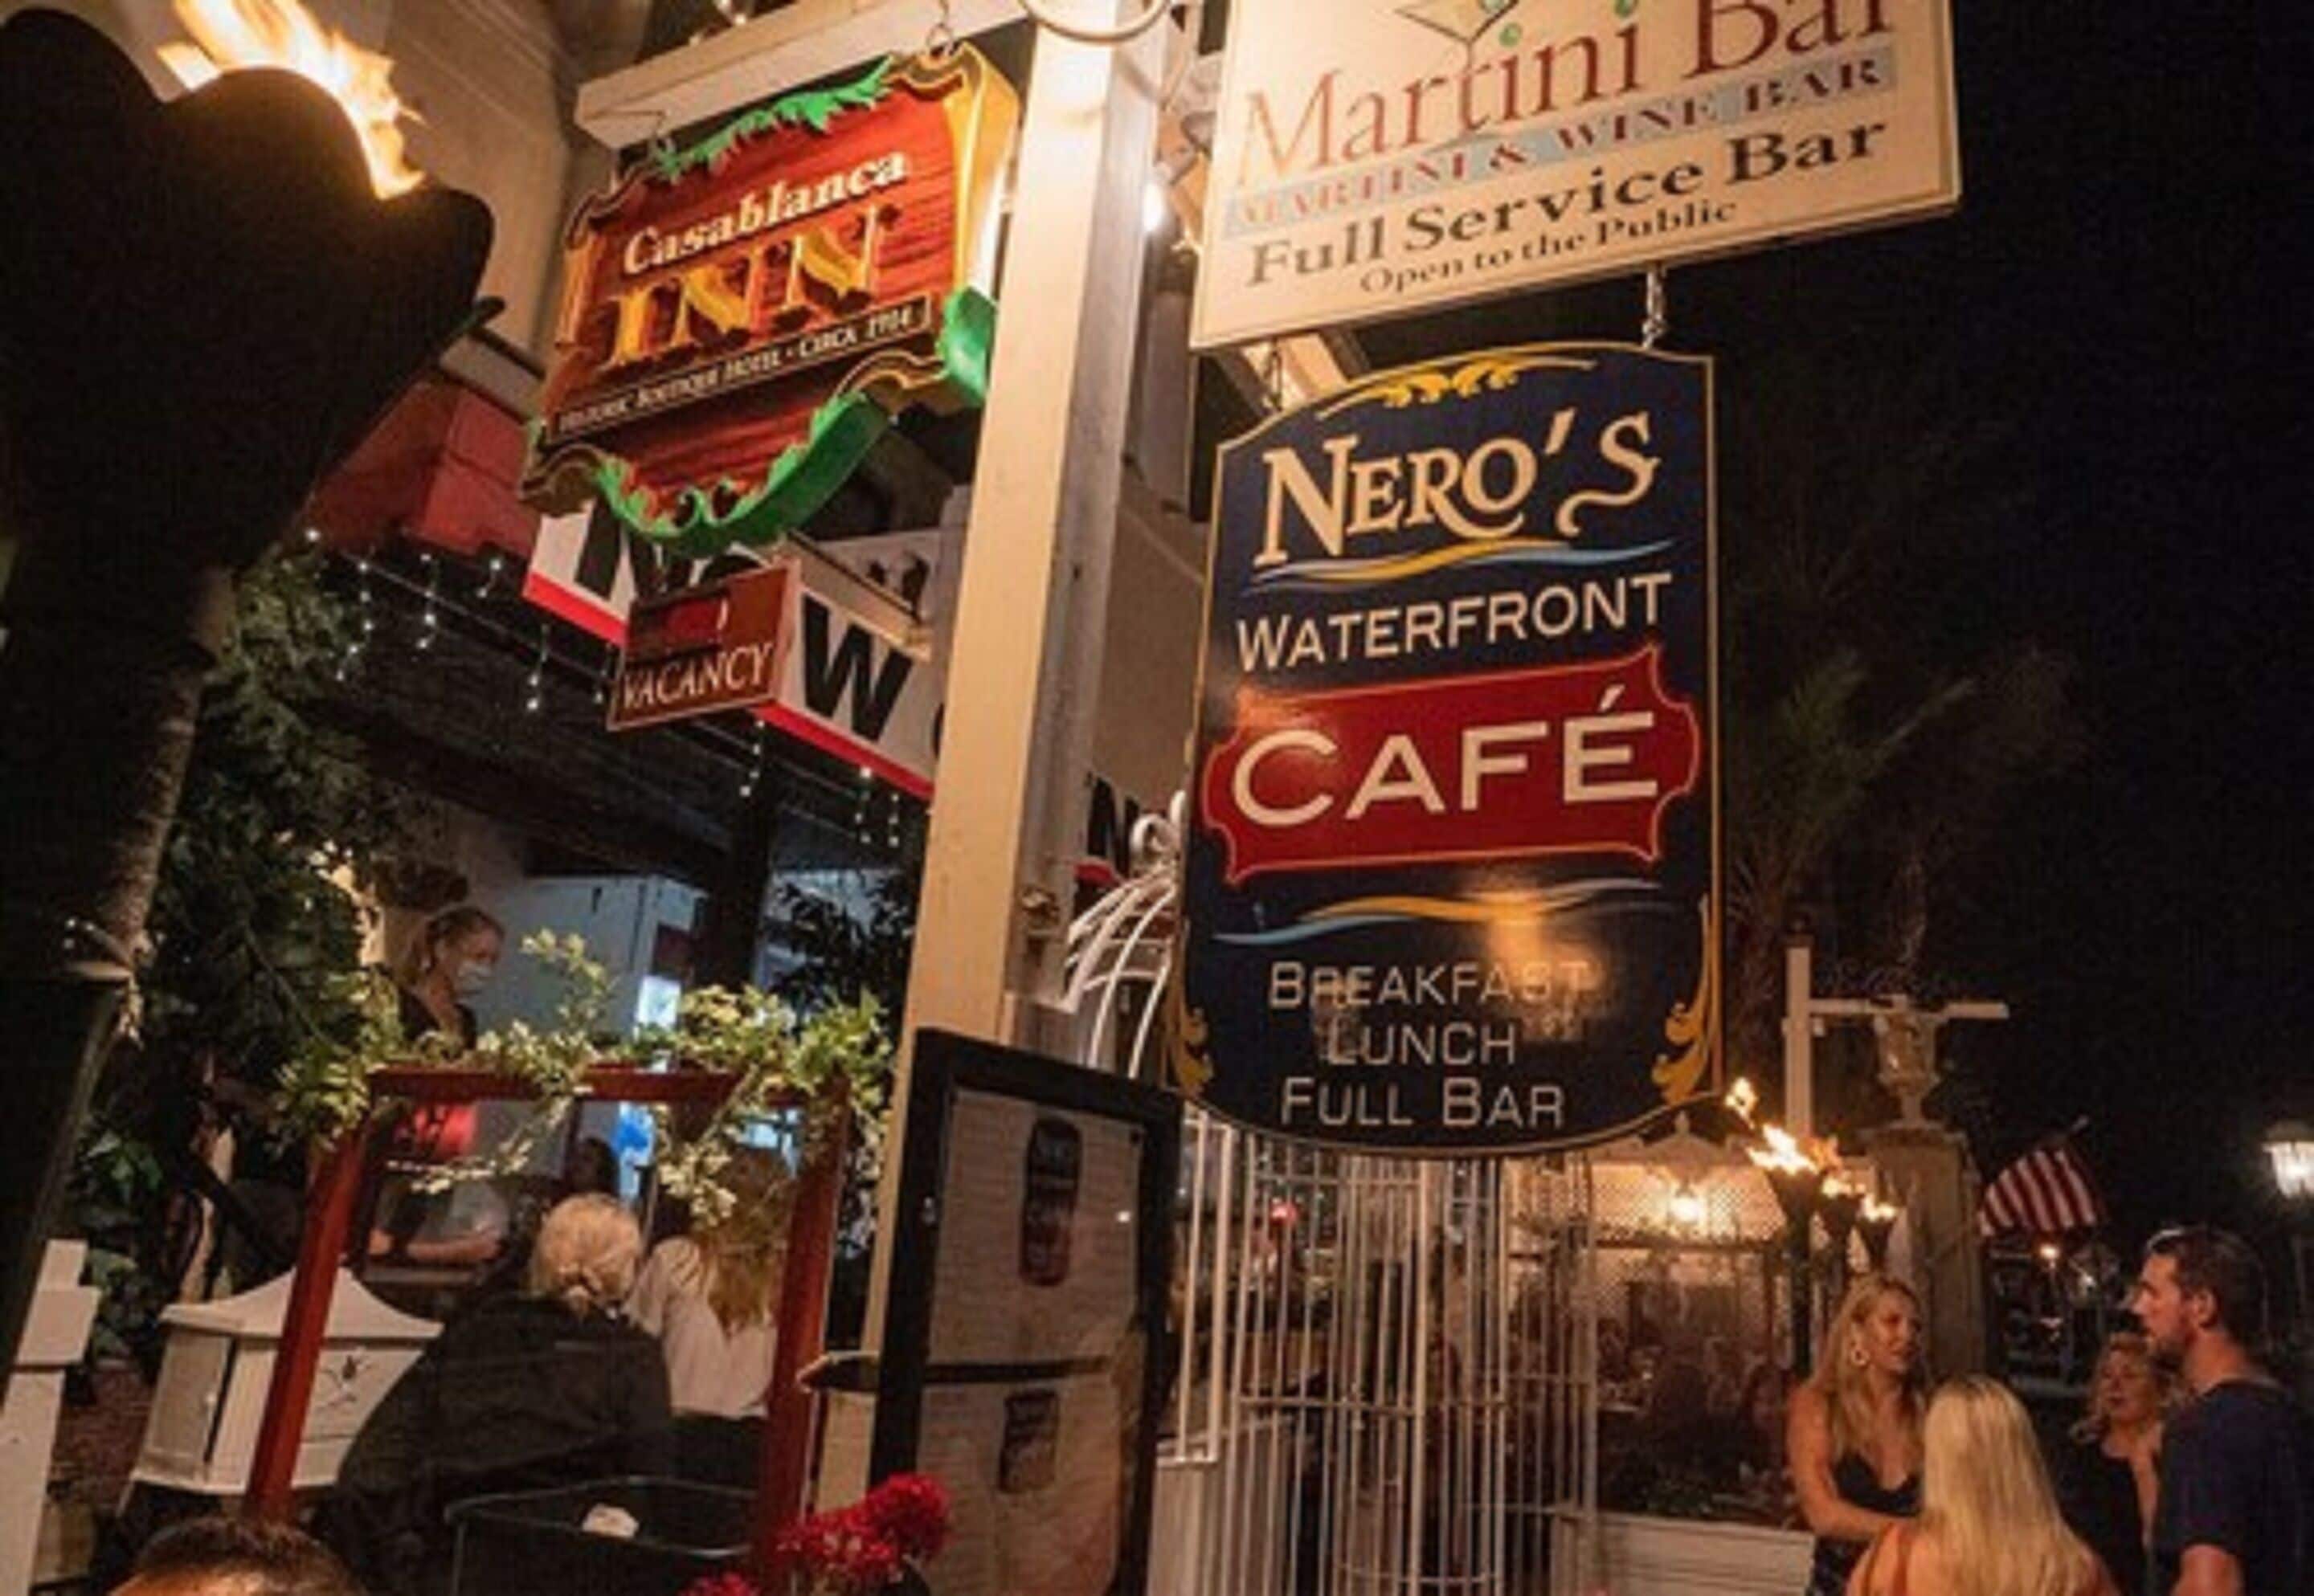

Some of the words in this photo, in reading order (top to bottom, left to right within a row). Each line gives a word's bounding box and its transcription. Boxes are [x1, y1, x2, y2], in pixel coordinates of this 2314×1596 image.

[1237, 0, 1641, 185] Martini
[1244, 151, 1466, 223] MARTINI
[1489, 142, 1527, 171] &
[1557, 98, 1719, 151] WINE
[1742, 59, 1881, 114] BAR
[623, 151, 907, 276] Casablanca
[1246, 215, 1387, 287] Full
[1404, 163, 1704, 252] Service
[1725, 122, 1887, 186] Bar
[1359, 258, 1464, 292] Open
[1474, 244, 1512, 270] to
[1521, 231, 1584, 259] the
[1596, 199, 1736, 245] Public
[599, 202, 888, 372] INN
[1253, 407, 1662, 567] NERO'S
[622, 642, 774, 708] VACANCY
[1237, 572, 1673, 672] WATERFRONT
[1231, 684, 1659, 827] CAFÉ
[1269, 961, 1592, 1010] BREAKFAST
[1326, 1022, 1518, 1067] LUNCH
[1281, 1076, 1413, 1126] FULL
[1441, 1077, 1565, 1128] BAR
